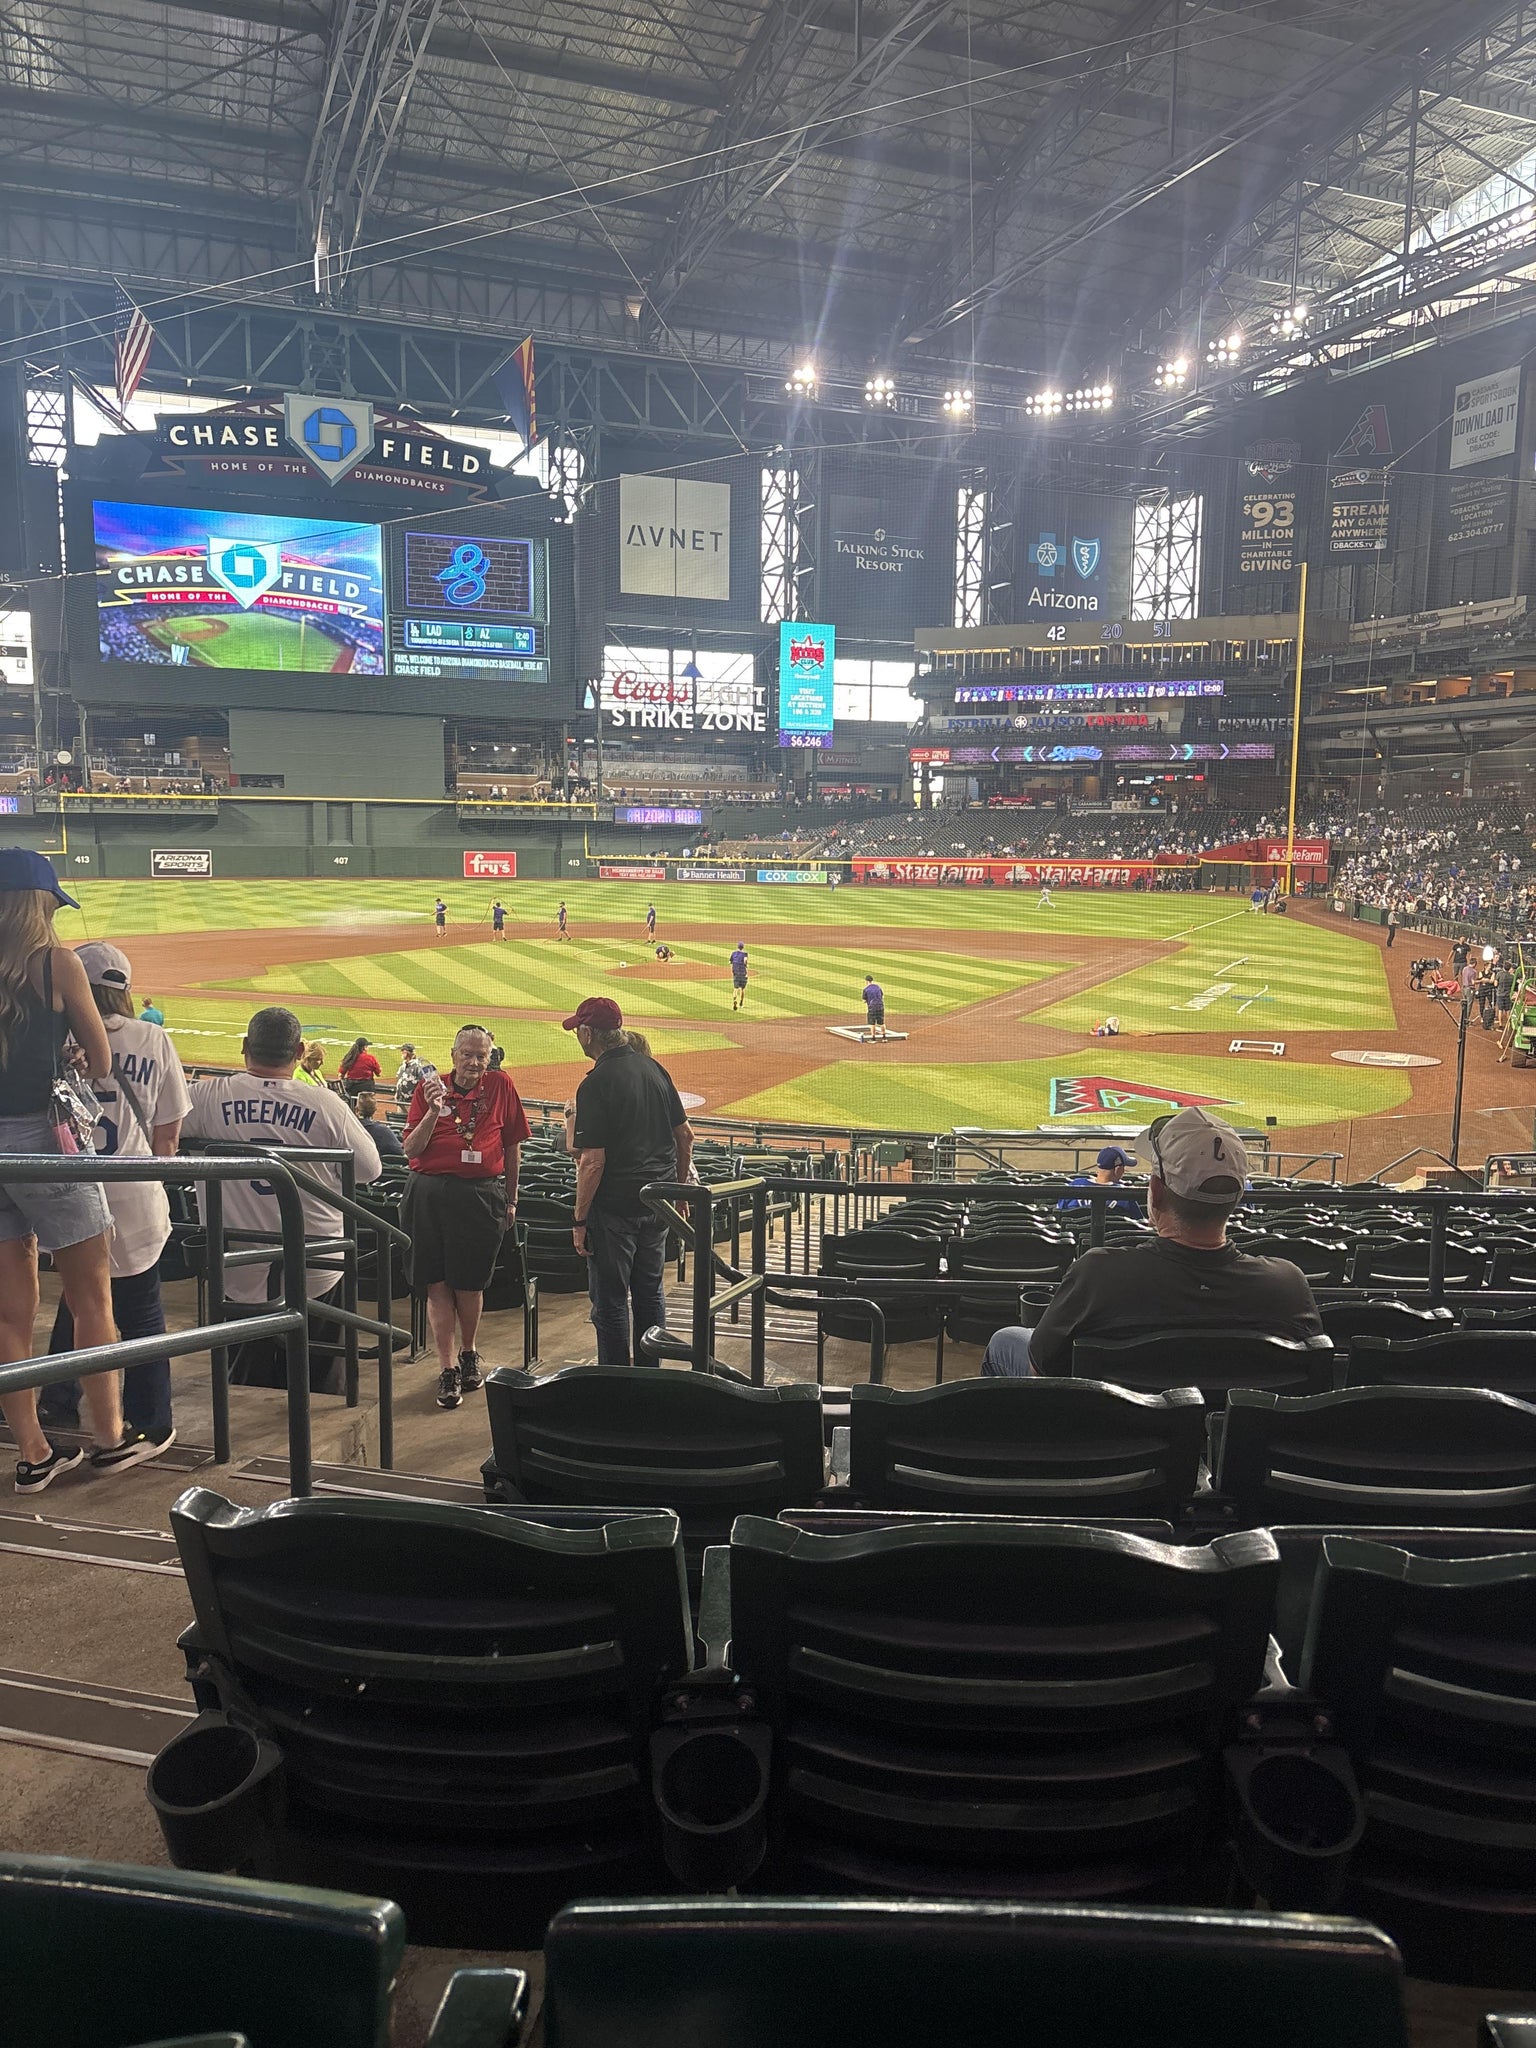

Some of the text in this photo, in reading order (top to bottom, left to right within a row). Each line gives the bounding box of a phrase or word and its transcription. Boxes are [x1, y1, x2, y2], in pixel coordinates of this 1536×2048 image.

[1471, 386, 1517, 408] SPORTSBOOK
[1472, 382, 1499, 396] CAESARS
[1454, 403, 1516, 437] DOWNLOAD IT
[1466, 436, 1478, 445] USE
[1469, 440, 1496, 453] DBACKS
[169, 425, 480, 474] CHASE FIELD
[211, 462, 445, 492] HOME OF THE DIAMONDBACKS
[1244, 493, 1296, 501] CELEBRATING
[1243, 500, 1294, 528] $93
[1332, 504, 1390, 517] STREAM
[1460, 508, 1494, 522] LOCATION
[1332, 518, 1388, 528] ANY GAME
[626, 524, 723, 552] AVNET
[1242, 528, 1294, 540] MILLION
[1331, 528, 1388, 538] ANYWHERE
[1448, 522, 1504, 542] 623.304.0777
[834, 540, 924, 560] TALKING STICK
[1241, 550, 1292, 559] CHARITABLE
[856, 556, 904, 572] RESORT
[1240, 559, 1292, 572] GIVING
[118, 566, 360, 598] CHASE FIELD
[263, 596, 334, 612] DIAMONDBACKS
[1028, 586, 1098, 611] Arizona
[426, 624, 442, 636] LAD
[480, 628, 490, 640] AZ
[1046, 626, 1066, 641] 42
[1100, 624, 1123, 639] 20
[1154, 622, 1172, 638] 51
[410, 654, 434, 664] WELCOME
[434, 656, 440, 665] TO
[440, 656, 462, 666] ARIZONA
[462, 658, 498, 668] DIAMONDBACKS
[524, 661, 536, 670] HERE
[536, 662, 543, 670] AT
[395, 665, 441, 676] CHASE FIELD
[612, 670, 688, 703] Coors
[696, 681, 766, 706] LIGHT
[612, 706, 766, 732] STRIKE ZONE
[948, 714, 1148, 729] ESTRELLA JALISCO CANTINA
[791, 736, 822, 748] $6,246
[626, 808, 672, 824] ARIZONA
[74, 856, 90, 864] 413
[334, 856, 349, 865] 407
[470, 854, 511, 875] fry's
[690, 870, 740, 880] Banner Health
[765, 872, 819, 882] COX COX
[221, 1100, 317, 1134] FREEMAN
